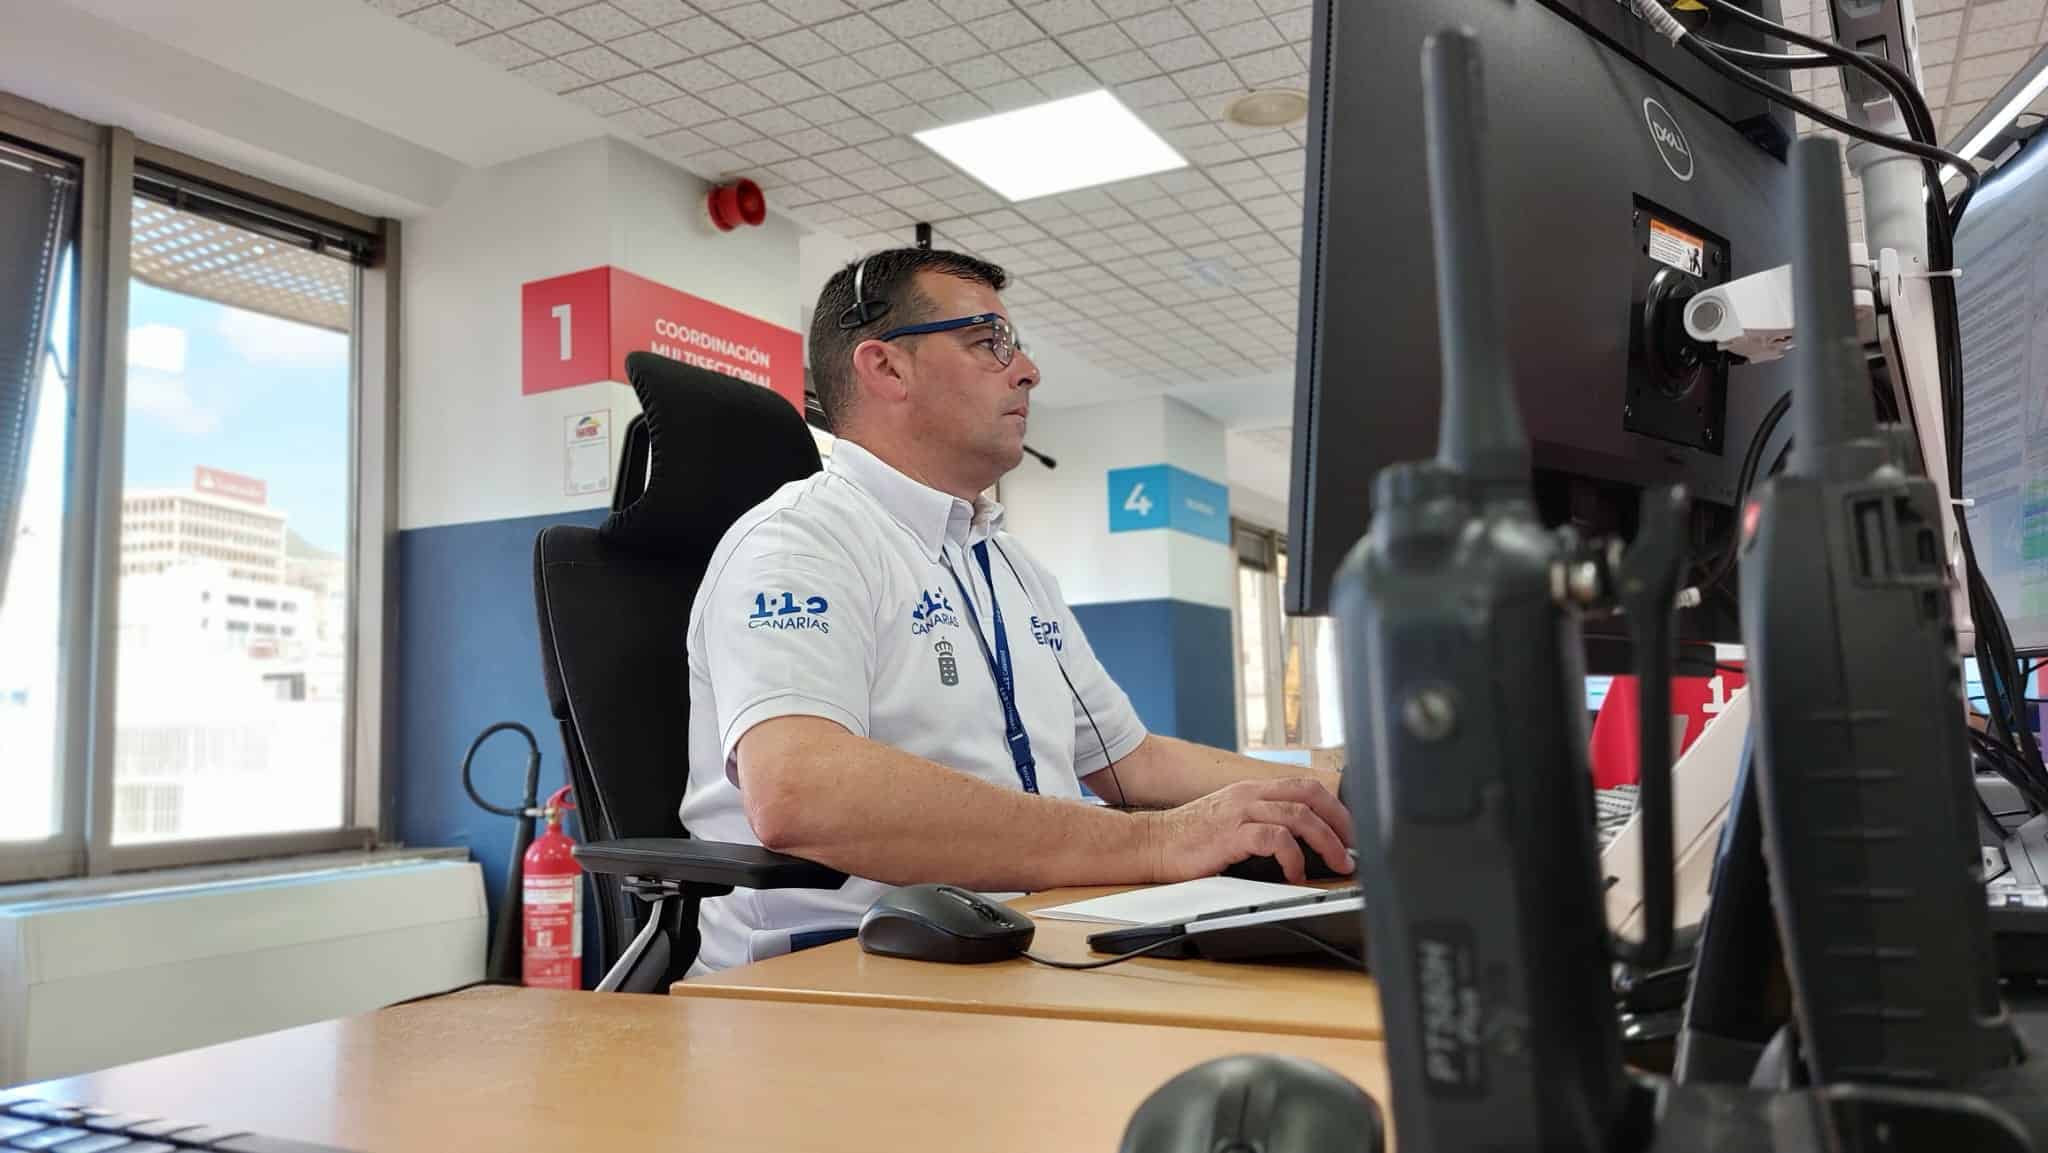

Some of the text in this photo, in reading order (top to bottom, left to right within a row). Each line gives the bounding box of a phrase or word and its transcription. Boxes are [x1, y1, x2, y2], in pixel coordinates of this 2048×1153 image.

[1652, 120, 1689, 156] DELL
[551, 303, 572, 361] 1
[655, 318, 771, 369] COORDINACIÓN
[1123, 482, 1153, 517] 4
[748, 616, 829, 634] CANARIAS
[911, 613, 960, 635] CANARIAS
